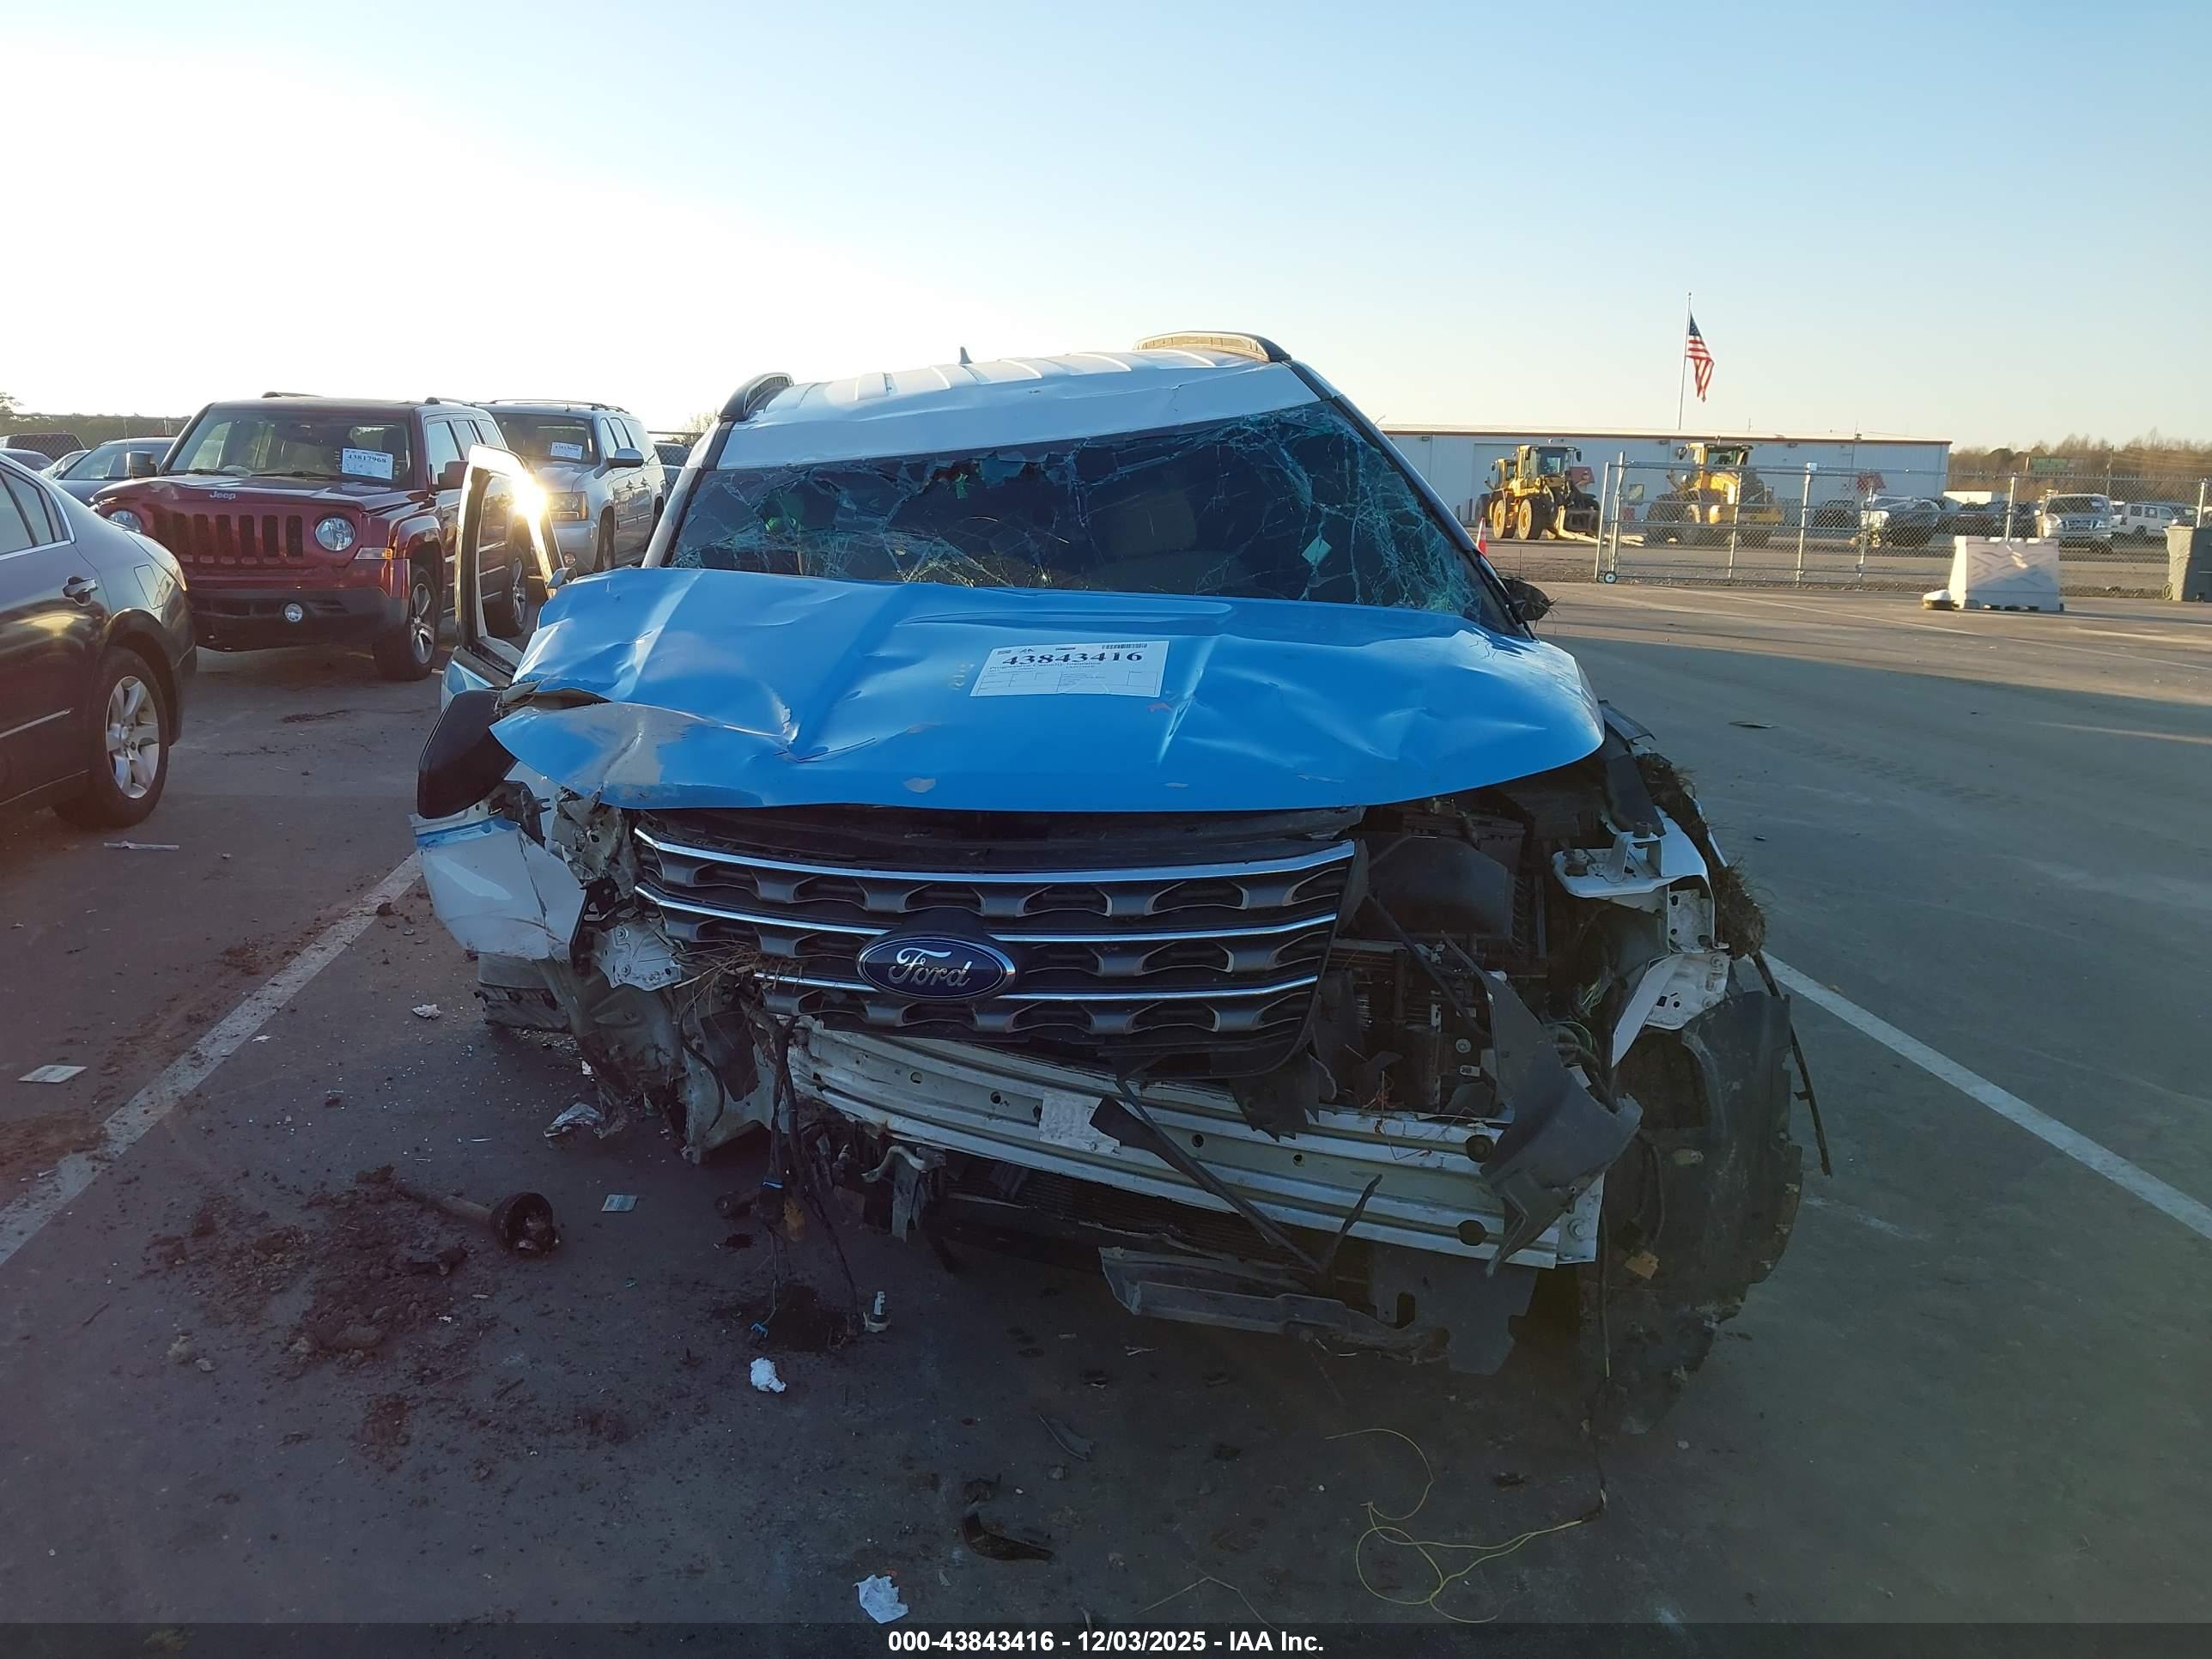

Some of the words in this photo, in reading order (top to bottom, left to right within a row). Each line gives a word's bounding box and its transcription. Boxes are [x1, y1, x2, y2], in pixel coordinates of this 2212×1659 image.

[347, 454, 386, 464] 43817968
[209, 490, 236, 500] Jeep
[1002, 651, 1144, 665] 43843416
[887, 947, 973, 988] Ford
